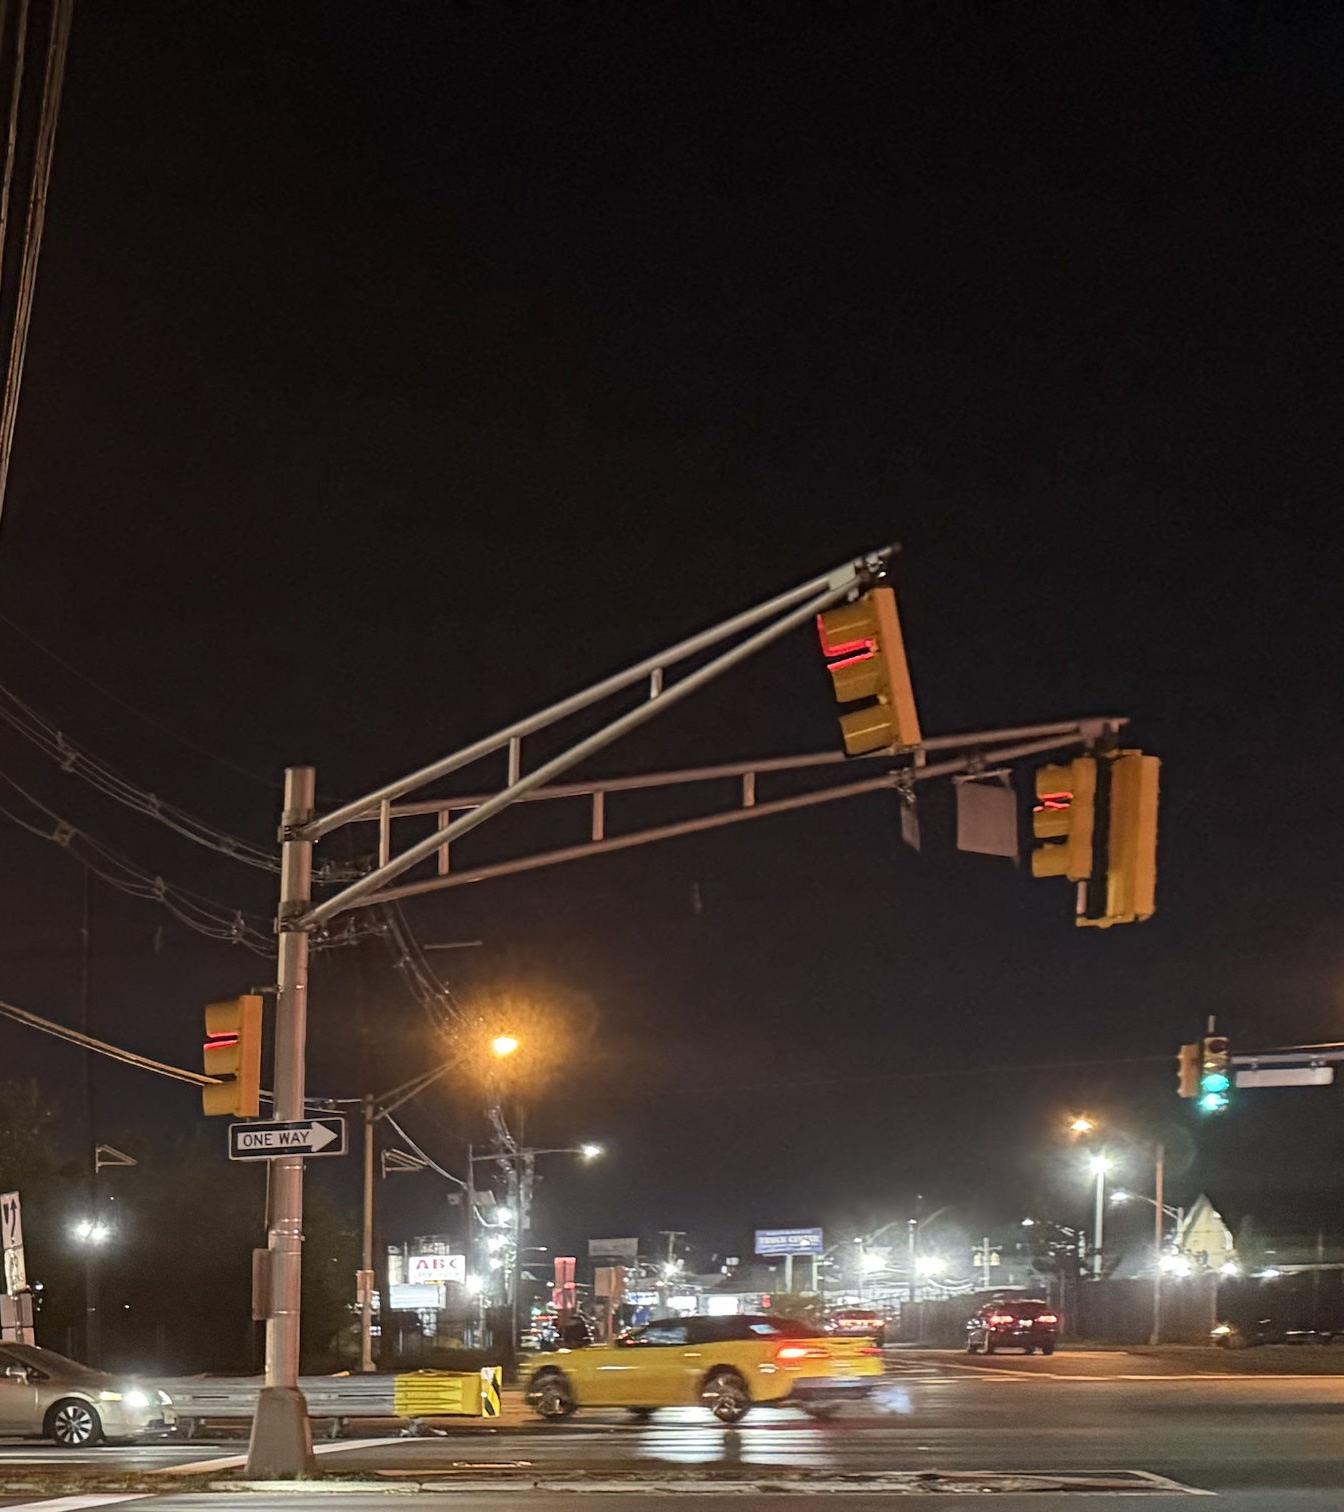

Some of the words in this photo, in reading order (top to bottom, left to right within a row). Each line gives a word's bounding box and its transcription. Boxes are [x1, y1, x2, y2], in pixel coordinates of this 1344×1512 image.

[242, 1132, 274, 1147] ONE
[278, 1130, 310, 1145] WAY
[415, 1259, 459, 1270] ABC
